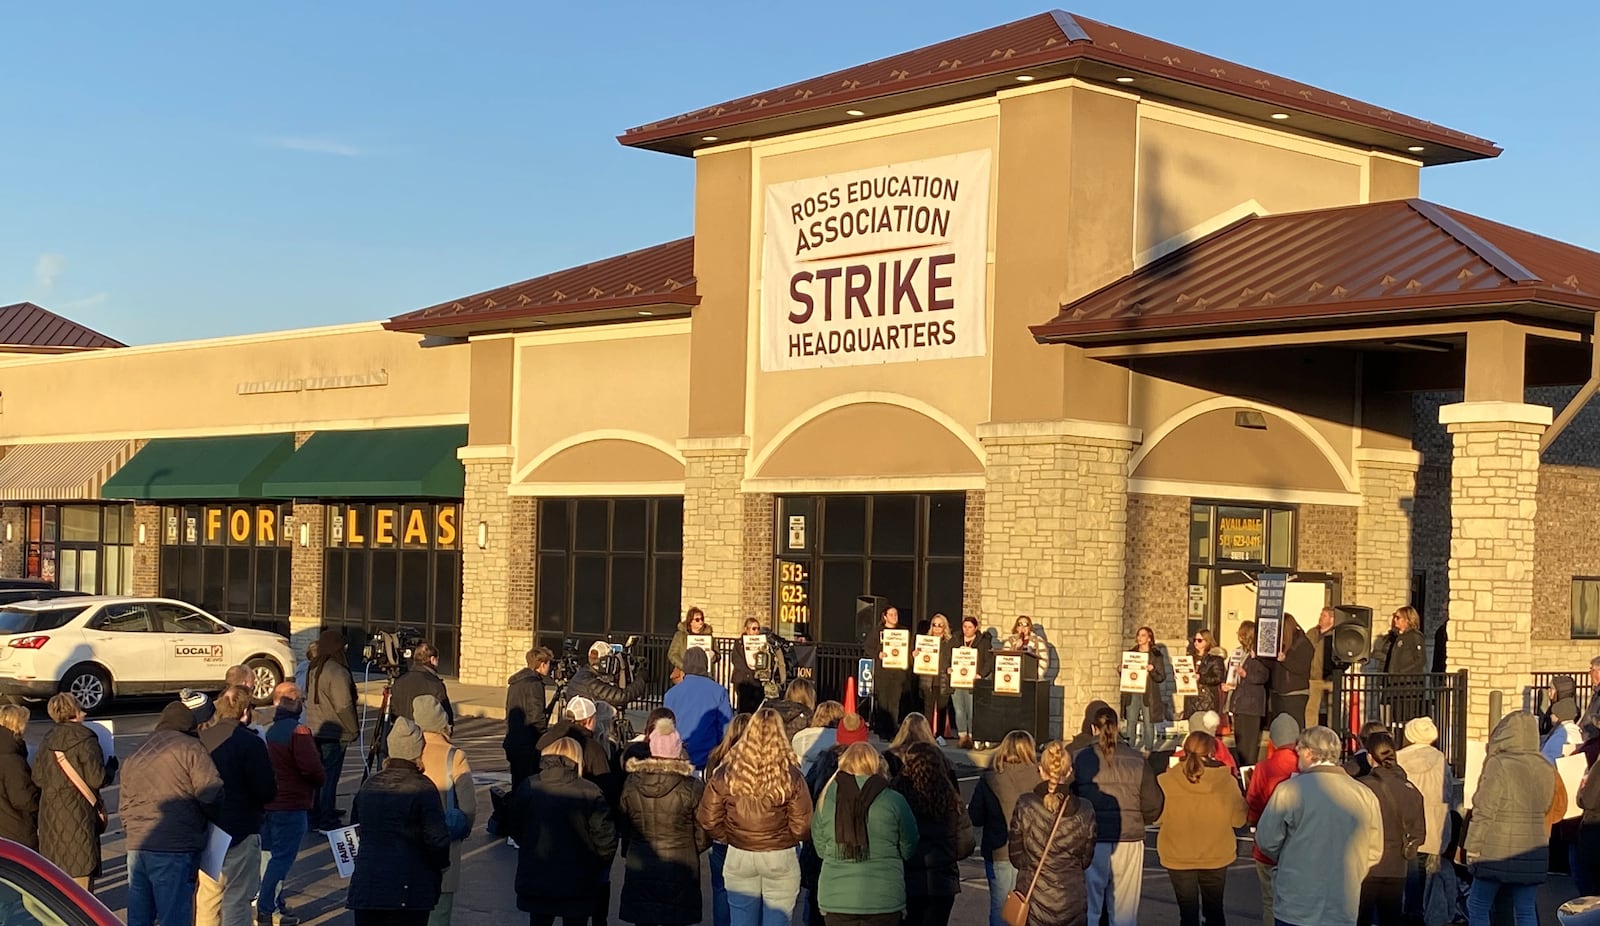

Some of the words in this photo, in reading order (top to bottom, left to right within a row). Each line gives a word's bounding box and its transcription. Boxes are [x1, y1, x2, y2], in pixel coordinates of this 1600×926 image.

[791, 187, 840, 224] ROSS
[847, 175, 959, 204] EDUCATION
[796, 205, 950, 256] ASSOCIATION
[788, 253, 956, 325] STRIKE
[789, 320, 956, 357] HEADQUARTERS
[208, 509, 275, 542] FOR
[1220, 518, 1261, 530] AVAILABLE
[782, 564, 808, 582] 513-
[781, 585, 807, 603] 623-
[781, 605, 807, 623] 0411
[176, 647, 211, 655] LOCAL
